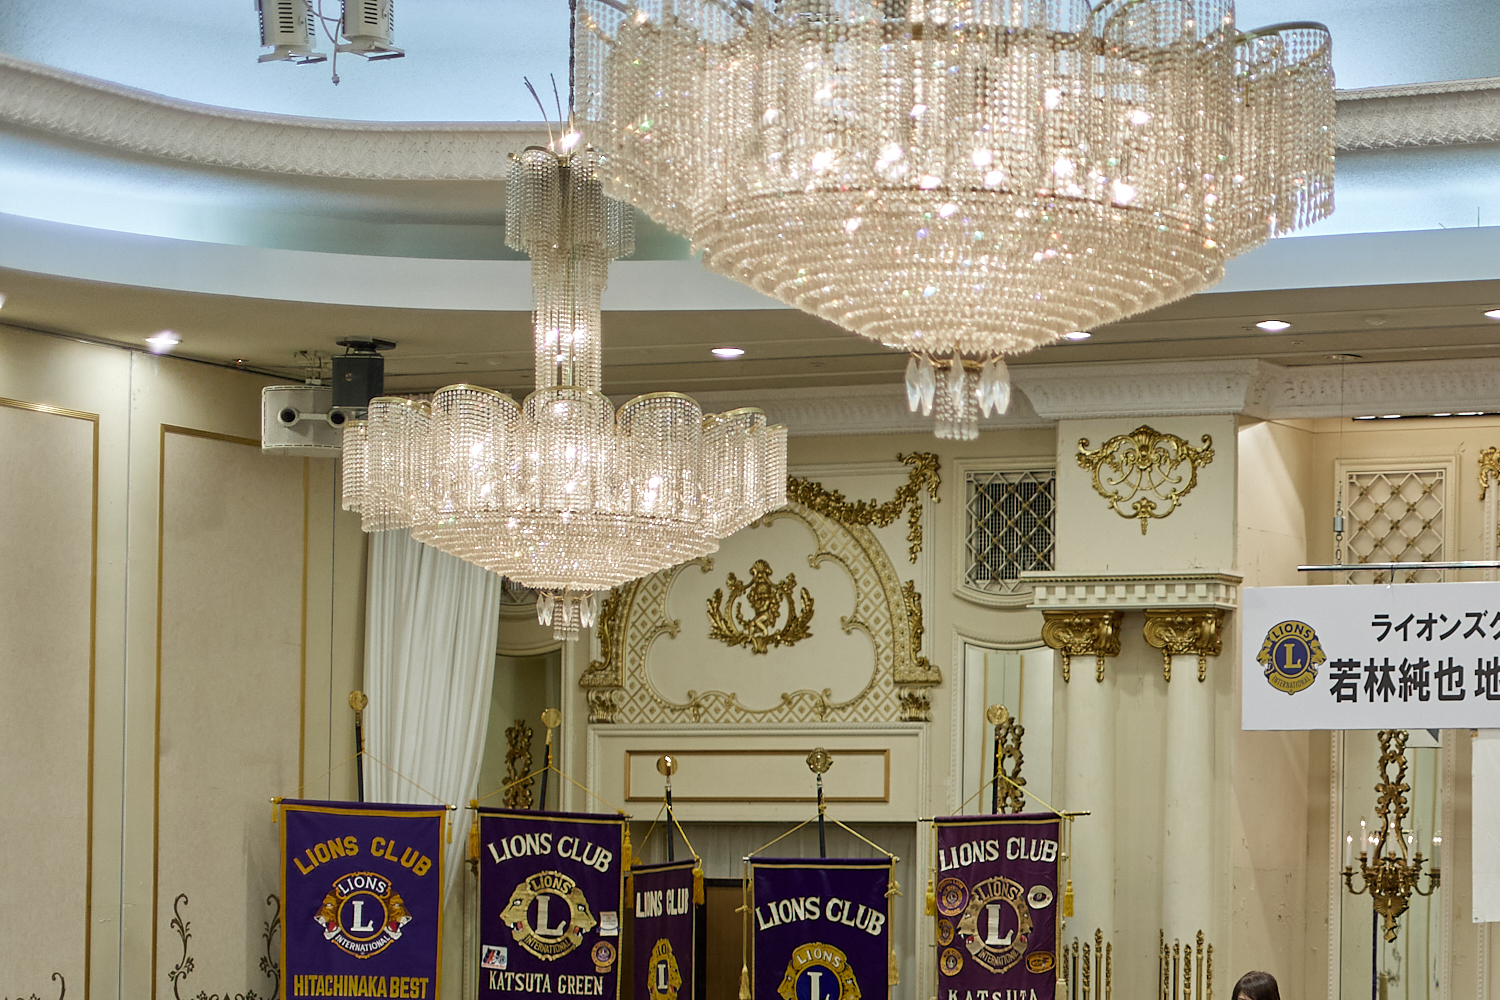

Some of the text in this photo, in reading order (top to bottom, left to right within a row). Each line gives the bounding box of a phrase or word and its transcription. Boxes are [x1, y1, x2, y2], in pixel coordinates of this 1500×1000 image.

[1272, 623, 1312, 639] LIONS
[1283, 643, 1302, 669] L
[1271, 675, 1312, 689] INTERNATIONAL
[293, 836, 432, 877] LIONS CLUB
[487, 832, 613, 873] LIONS CLUB
[938, 837, 1059, 872] LIONS CLUB
[337, 876, 387, 895] LIONS
[530, 875, 572, 895] LIONS
[977, 882, 1019, 902] LIONS
[535, 895, 567, 936] L
[635, 887, 690, 918] LIONS CLUB
[350, 900, 374, 932] L
[755, 896, 886, 937] LIONS CLUB
[985, 904, 1014, 946] L
[334, 933, 391, 952] INTERNATIONAL
[523, 935, 575, 954] INTERNATIONAL
[796, 948, 842, 968] LIONS
[293, 974, 429, 999] HITACHINAKA BEST
[488, 970, 604, 996] KATSUTA GREEN
